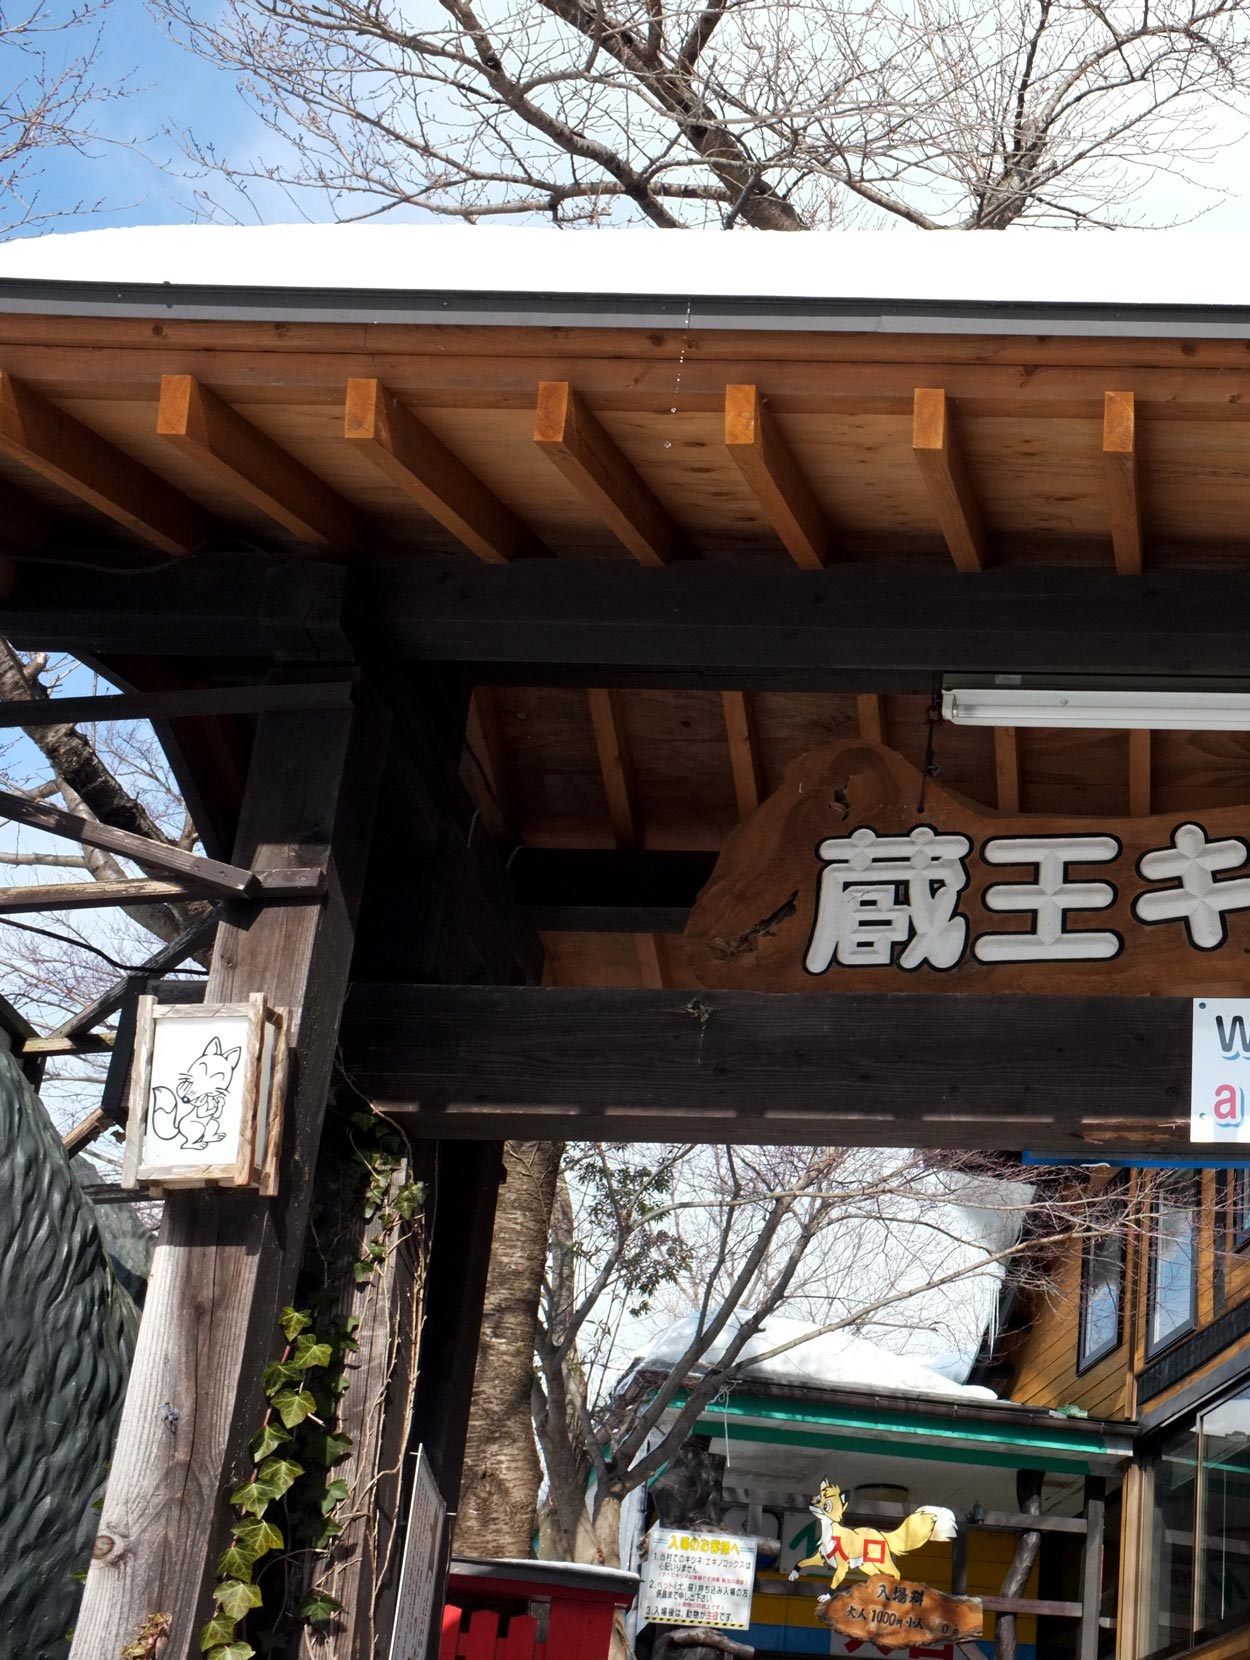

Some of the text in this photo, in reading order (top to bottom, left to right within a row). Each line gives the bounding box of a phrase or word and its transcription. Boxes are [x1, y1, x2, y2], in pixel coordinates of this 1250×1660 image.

[1213, 1084, 1237, 1120] a
[826, 1535, 886, 1564] 入口
[876, 1584, 925, 1607] 入場料
